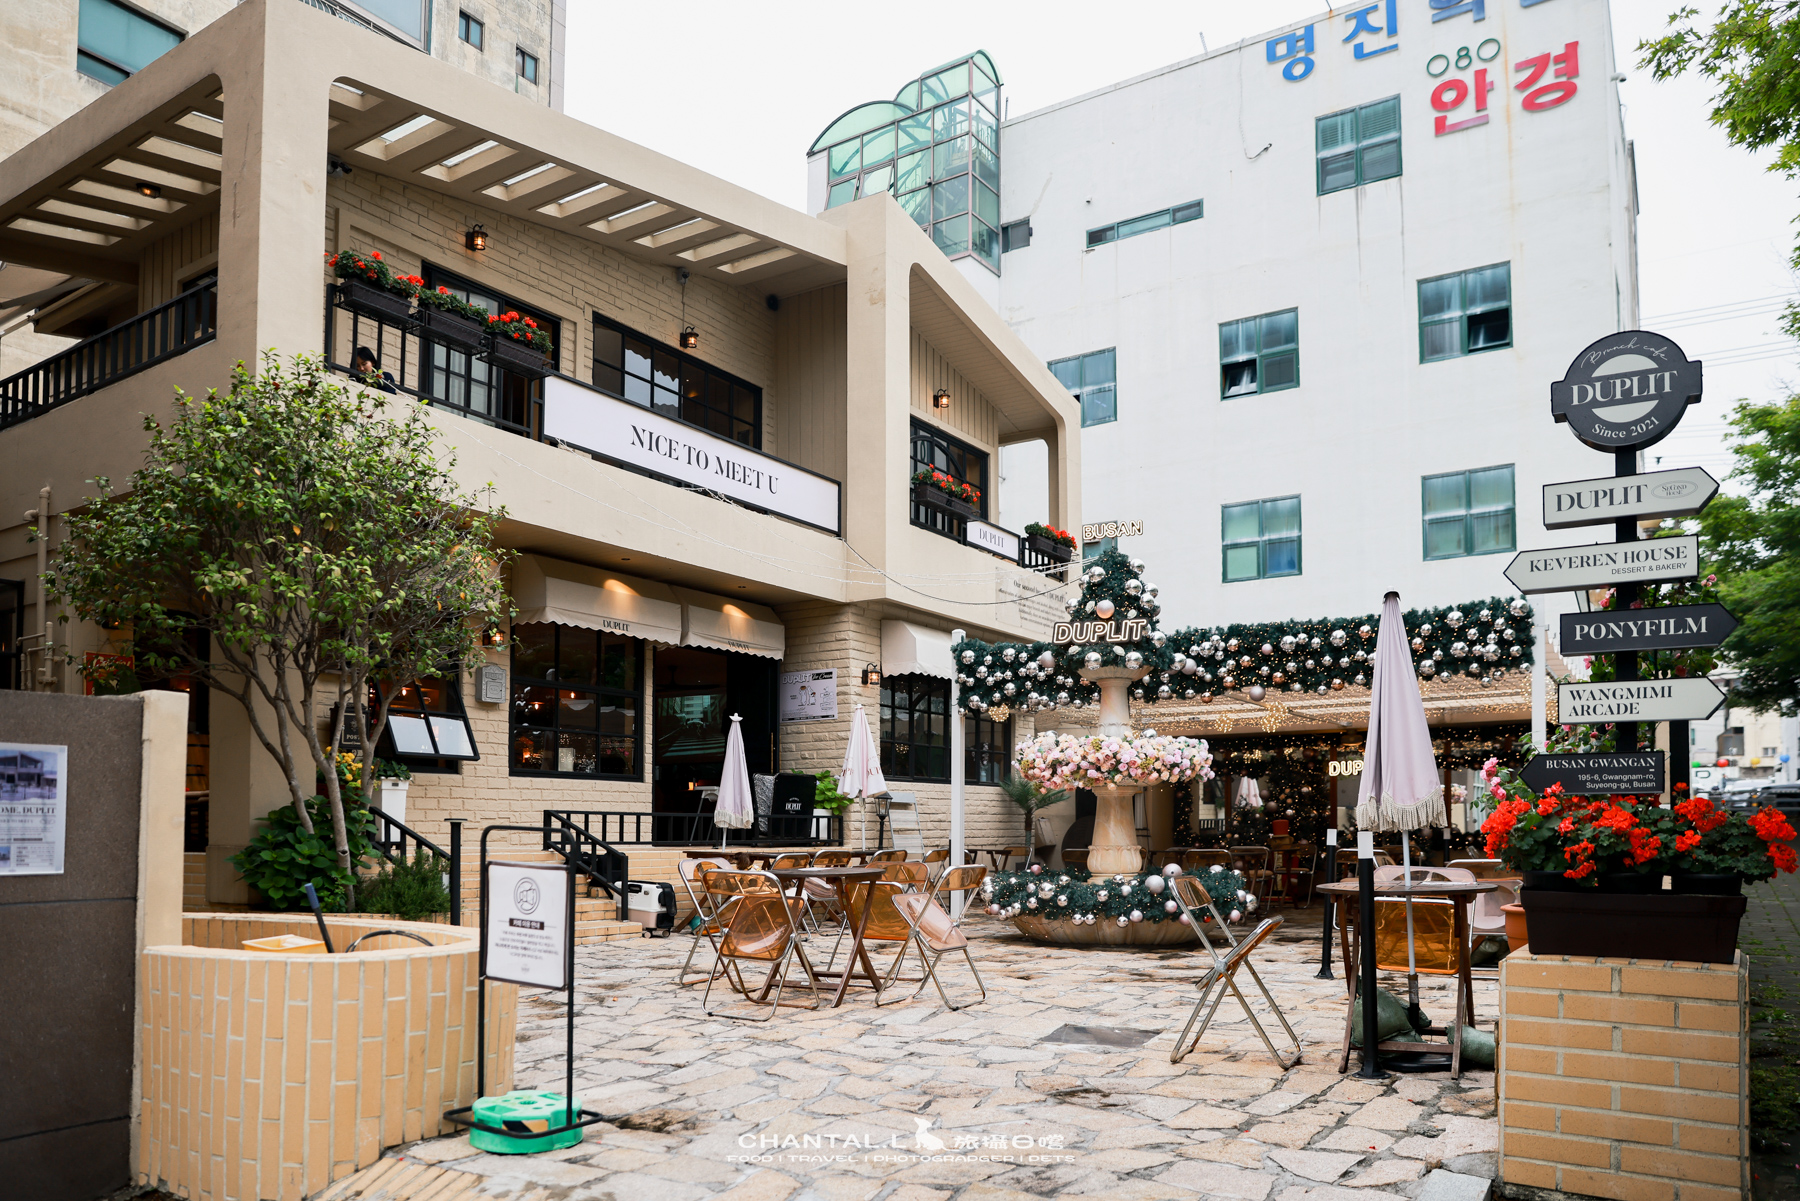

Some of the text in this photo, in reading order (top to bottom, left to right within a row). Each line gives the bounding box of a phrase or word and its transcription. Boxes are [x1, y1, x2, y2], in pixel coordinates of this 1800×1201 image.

[1430, 41, 1580, 137] 안경
[1570, 370, 1678, 406] DUPLIT
[1591, 416, 1660, 438] Since 2021
[630, 424, 779, 495] NICE TO MEET U
[1555, 484, 1649, 512] DUPLIT
[979, 528, 1005, 548] DUPLIT
[1082, 520, 1144, 540] BUSAN
[1529, 545, 1688, 573] KEVEREN HOUSE
[1611, 562, 1688, 575] DESSERT & BAKERY
[602, 619, 630, 632] DUPLIT
[1053, 619, 1147, 644] DUPLIT
[1574, 616, 1708, 641] PONYFILM
[1569, 685, 1673, 702] WANGMIMI
[1568, 702, 1640, 717] ARCADE
[1546, 757, 1656, 769] BUSAN GWANGAN
[1586, 781, 1631, 789] Suyeong-gu,
[1602, 773, 1656, 781] Gwangnam-ro,
[22, 806, 56, 814] DUPLIT
